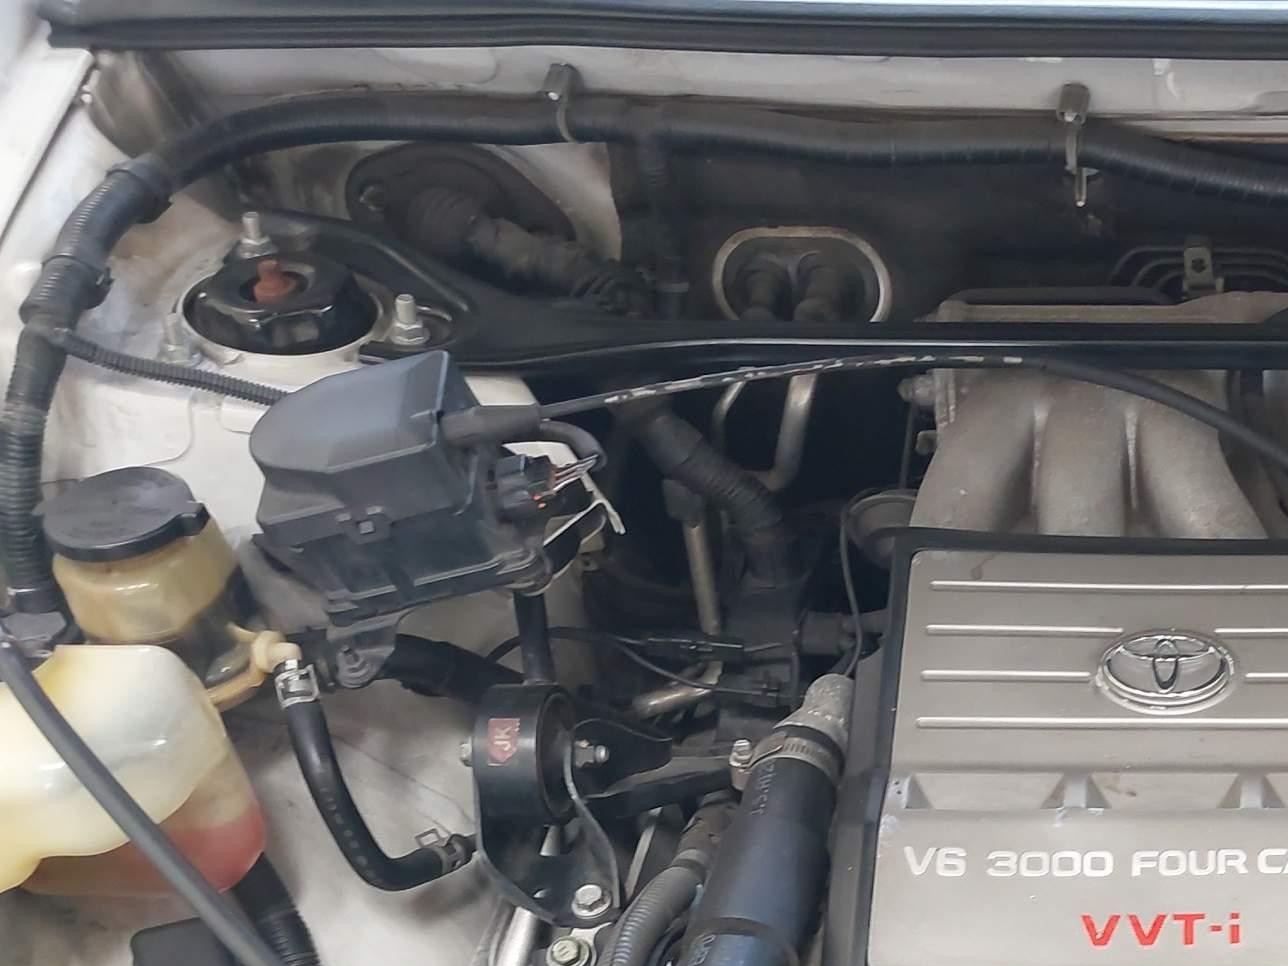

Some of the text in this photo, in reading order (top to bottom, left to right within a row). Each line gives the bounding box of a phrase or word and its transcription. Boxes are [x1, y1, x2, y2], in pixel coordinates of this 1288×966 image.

[902, 846, 967, 878] V6
[986, 850, 1113, 878] 3000
[1131, 849, 1248, 877] FOUR
[1081, 912, 1241, 947] VVT-i
